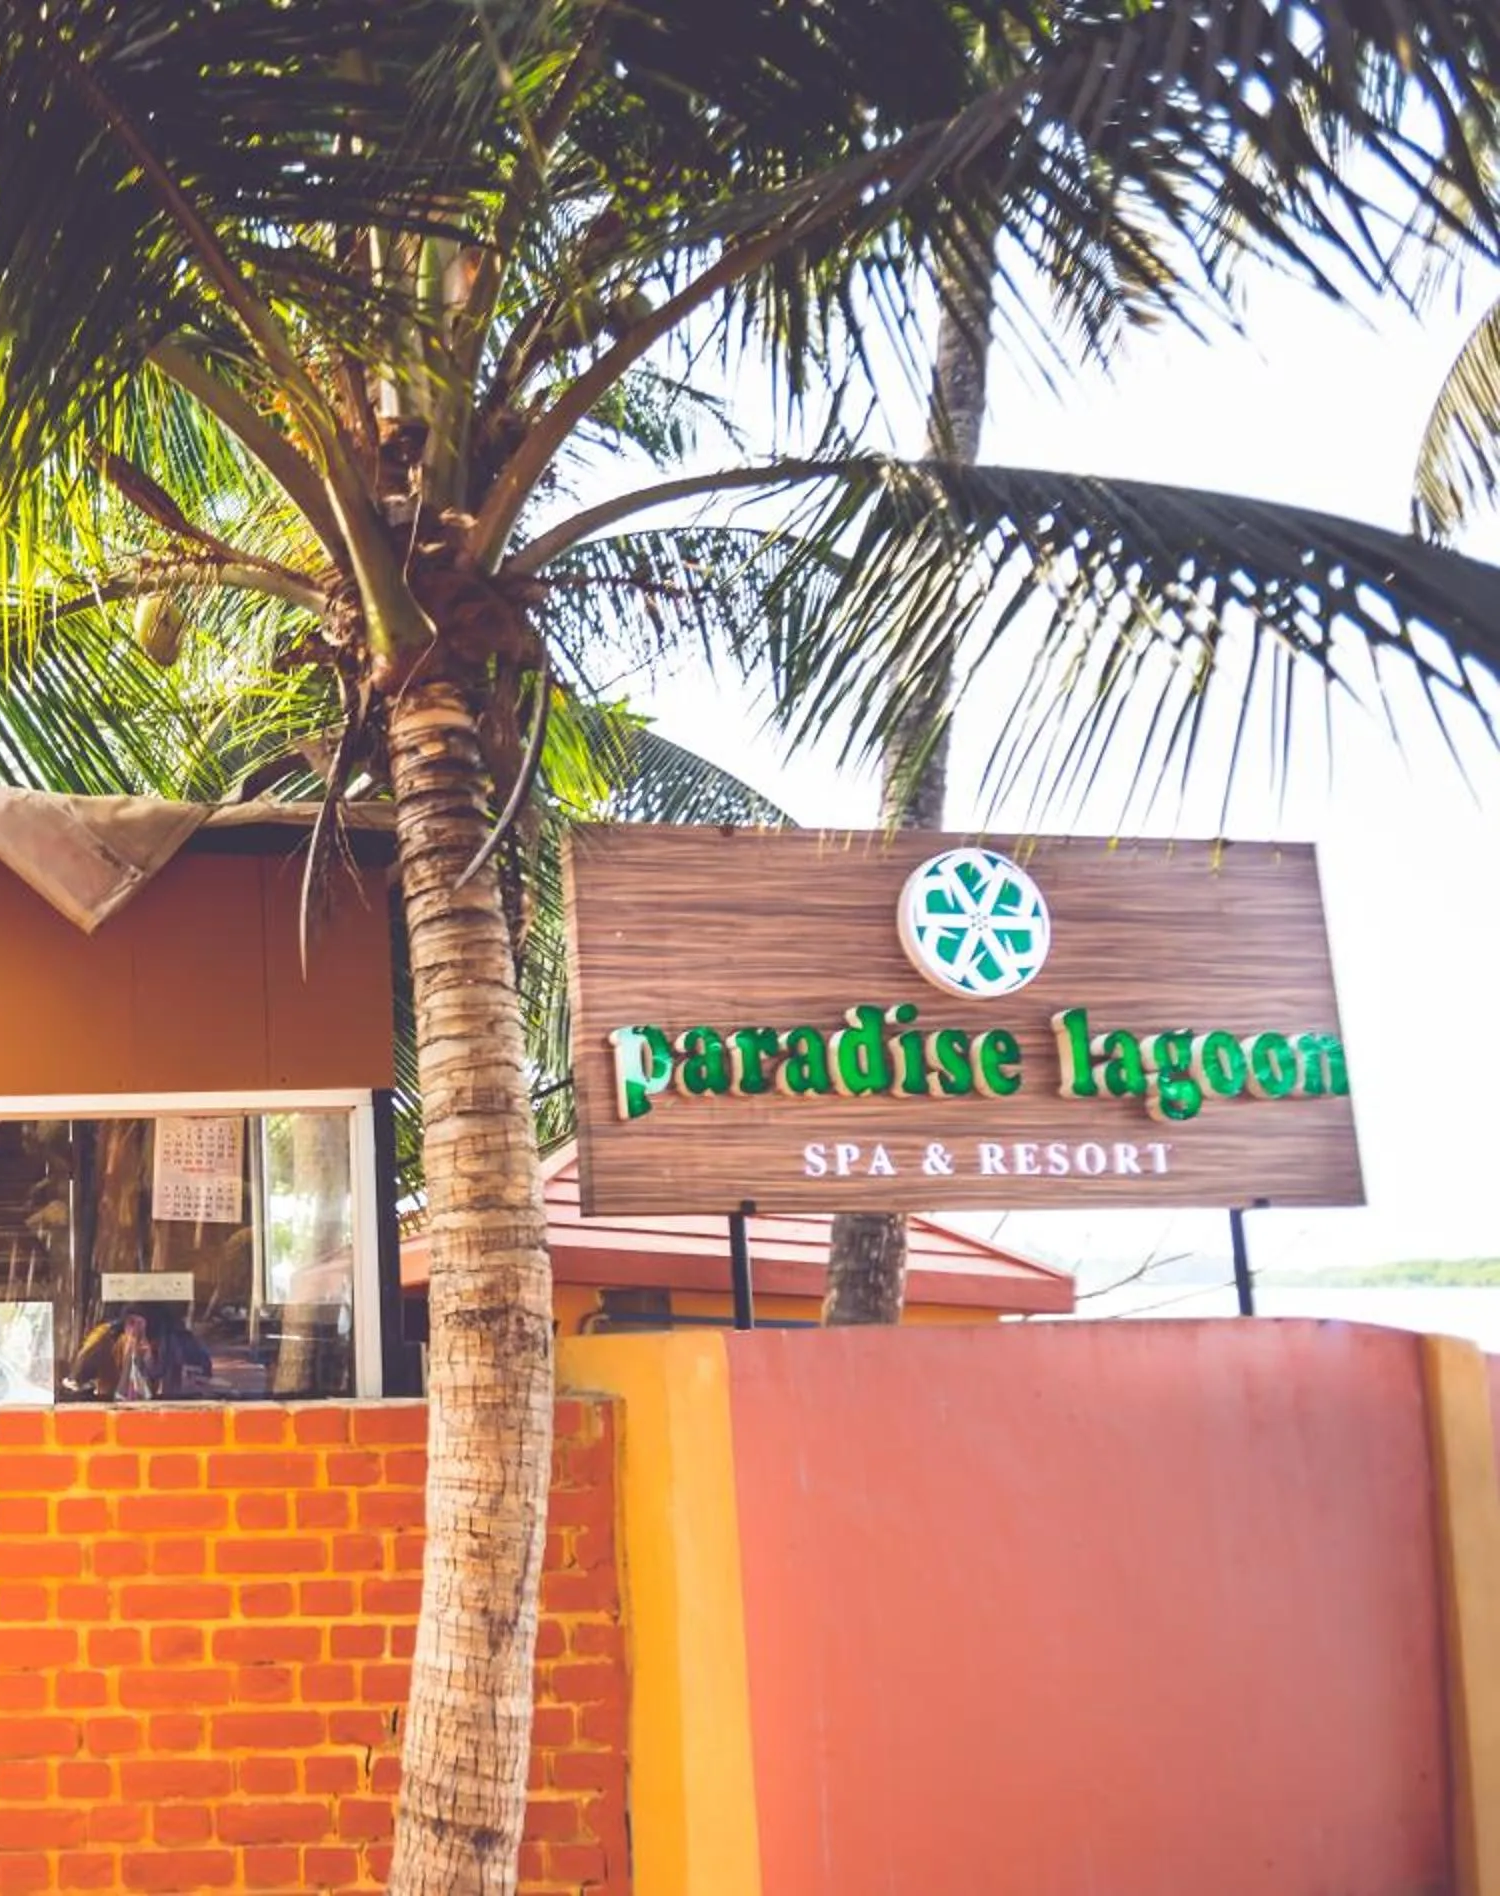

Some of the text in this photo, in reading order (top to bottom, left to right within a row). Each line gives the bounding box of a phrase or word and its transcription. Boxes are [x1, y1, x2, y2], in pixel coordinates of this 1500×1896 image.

[609, 1003, 1350, 1121] paradise lagoon
[804, 1142, 1173, 1176] SPA & RESORT
